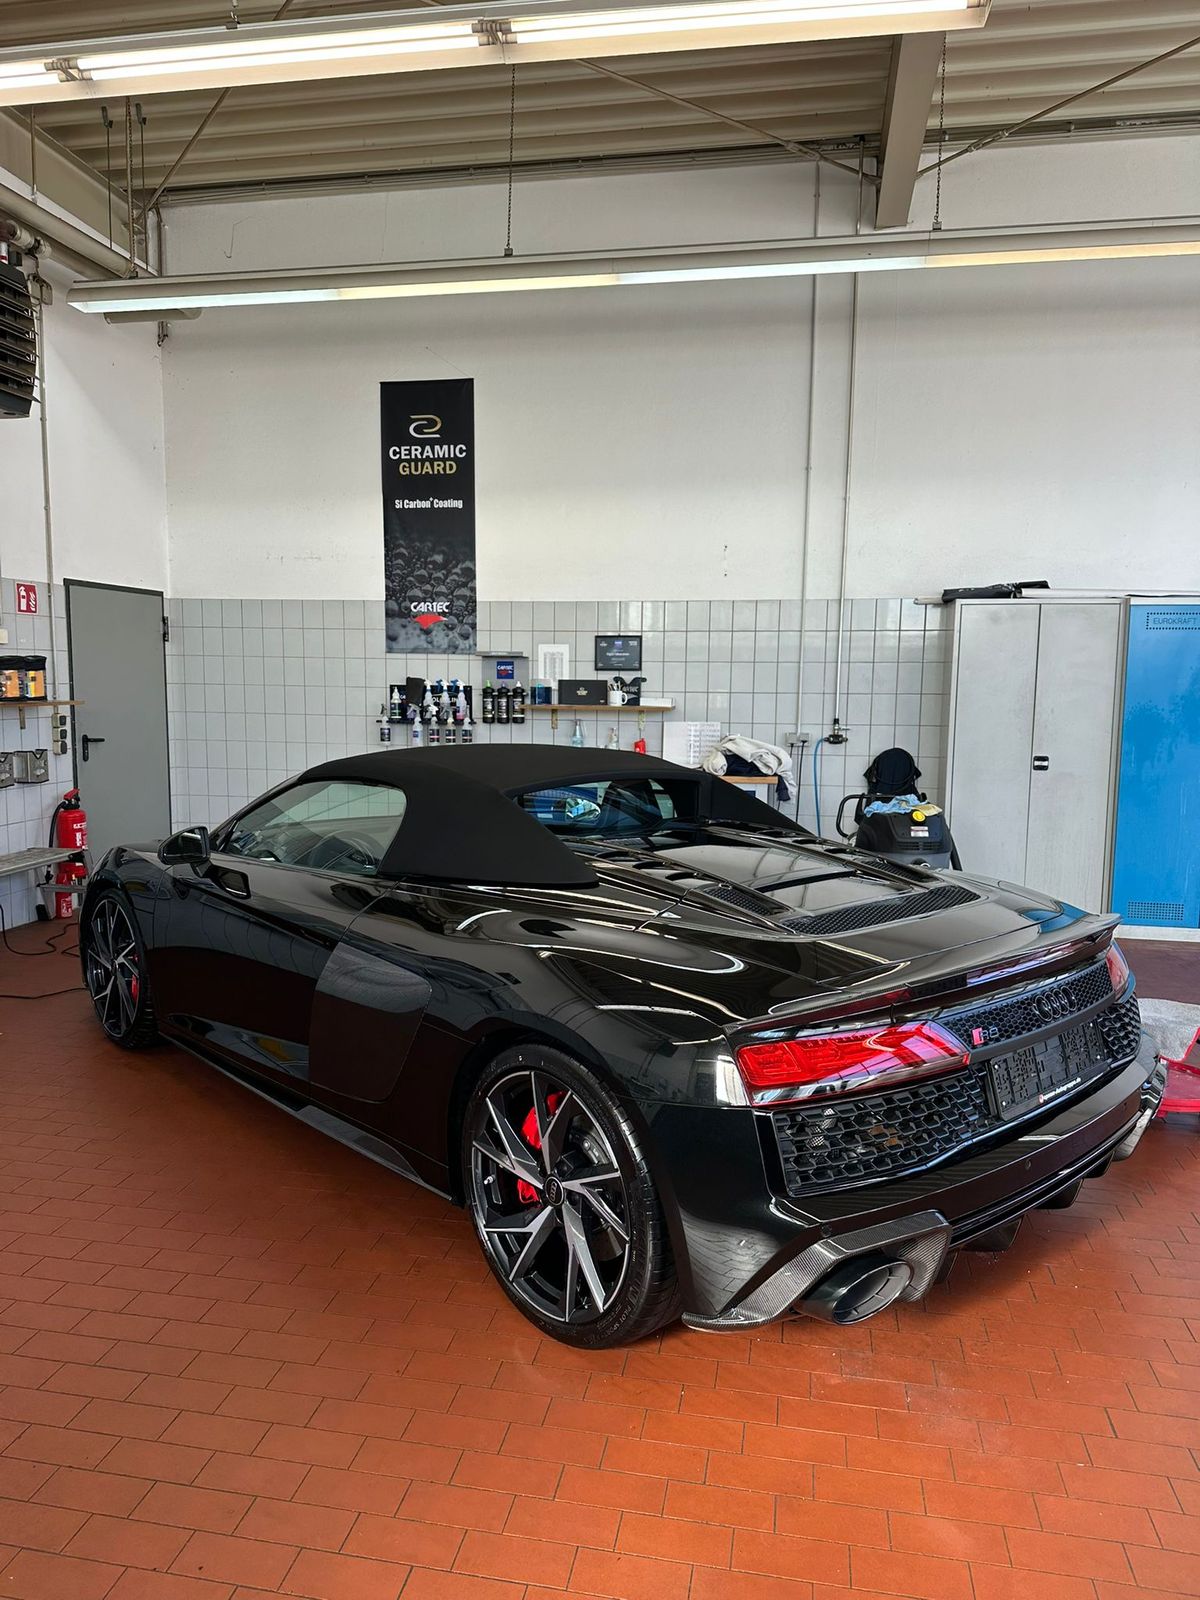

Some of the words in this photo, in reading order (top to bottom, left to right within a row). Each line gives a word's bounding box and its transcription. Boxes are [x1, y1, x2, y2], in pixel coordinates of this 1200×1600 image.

[388, 444, 467, 459] CERAMIC
[398, 461, 457, 475] GUARD
[395, 499, 403, 509] Si
[433, 498, 463, 509] Coating
[410, 601, 450, 613] CARTEC
[1153, 617, 1197, 625] EUROKRAFT
